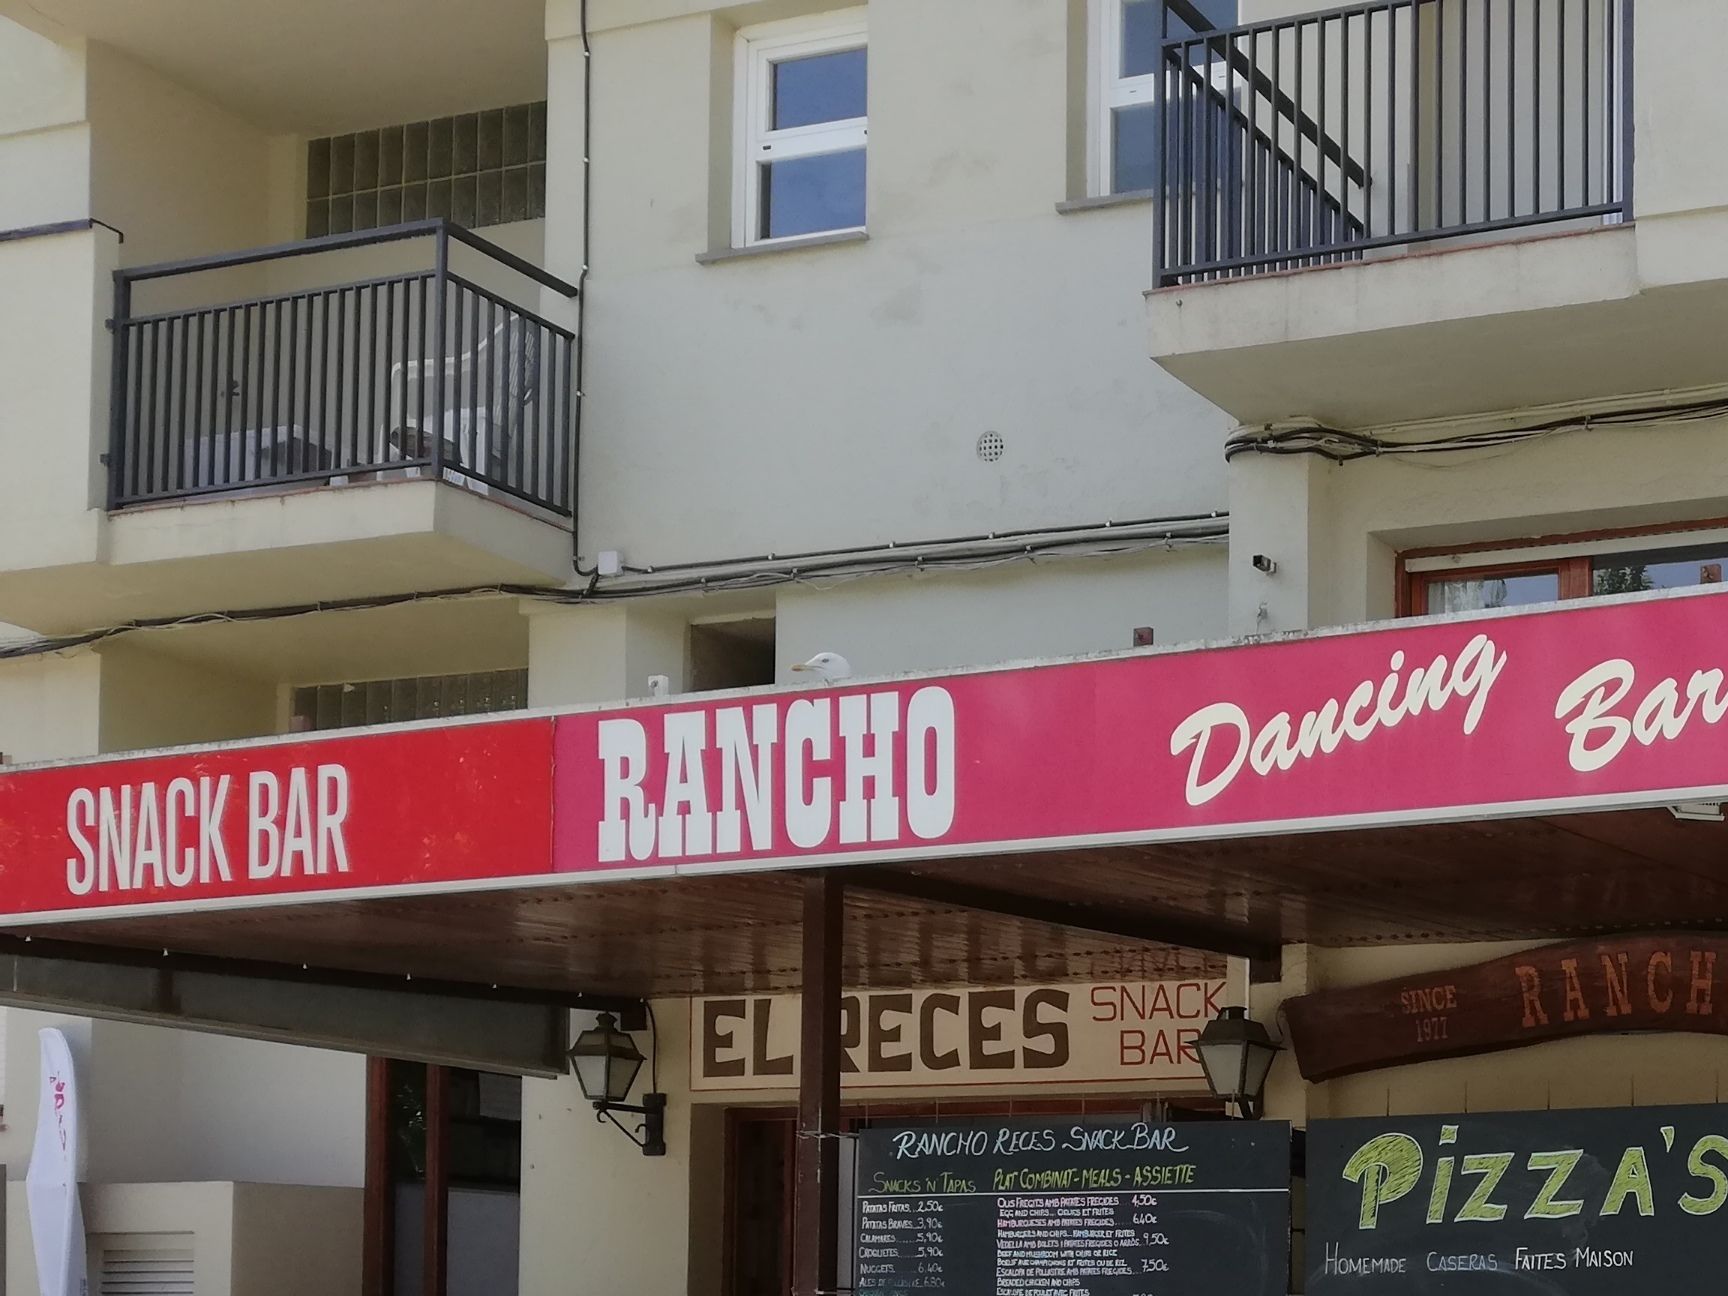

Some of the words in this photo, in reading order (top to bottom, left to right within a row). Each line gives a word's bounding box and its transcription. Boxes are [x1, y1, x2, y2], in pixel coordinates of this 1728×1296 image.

[1171, 633, 1507, 805] Dancing
[598, 686, 957, 862] RANCHO
[67, 774, 232, 896] SNACK
[250, 763, 350, 880] BAR
[1090, 981, 1227, 1021] SNACK
[1401, 985, 1459, 1015] SINCE
[703, 998, 795, 1078] EL
[1120, 1029, 1202, 1066] BAR
[1415, 1018, 1450, 1042] 1977
[893, 1131, 988, 1159] RANCHO
[993, 1128, 1055, 1156] RECES
[1062, 1126, 1129, 1152] SNACK
[1128, 1122, 1188, 1152] BAR
[868, 1171, 921, 1193] SNACKS
[939, 1171, 977, 1193] TAPAS
[993, 1168, 1019, 1191] PLAT
[1133, 1165, 1196, 1187] ASSIETTE
[1325, 1242, 1407, 1276] HOMEMADE
[1426, 1251, 1498, 1272] CASERAS
[1514, 1247, 1567, 1271] FAITES
[1576, 1246, 1634, 1269] MAISON
